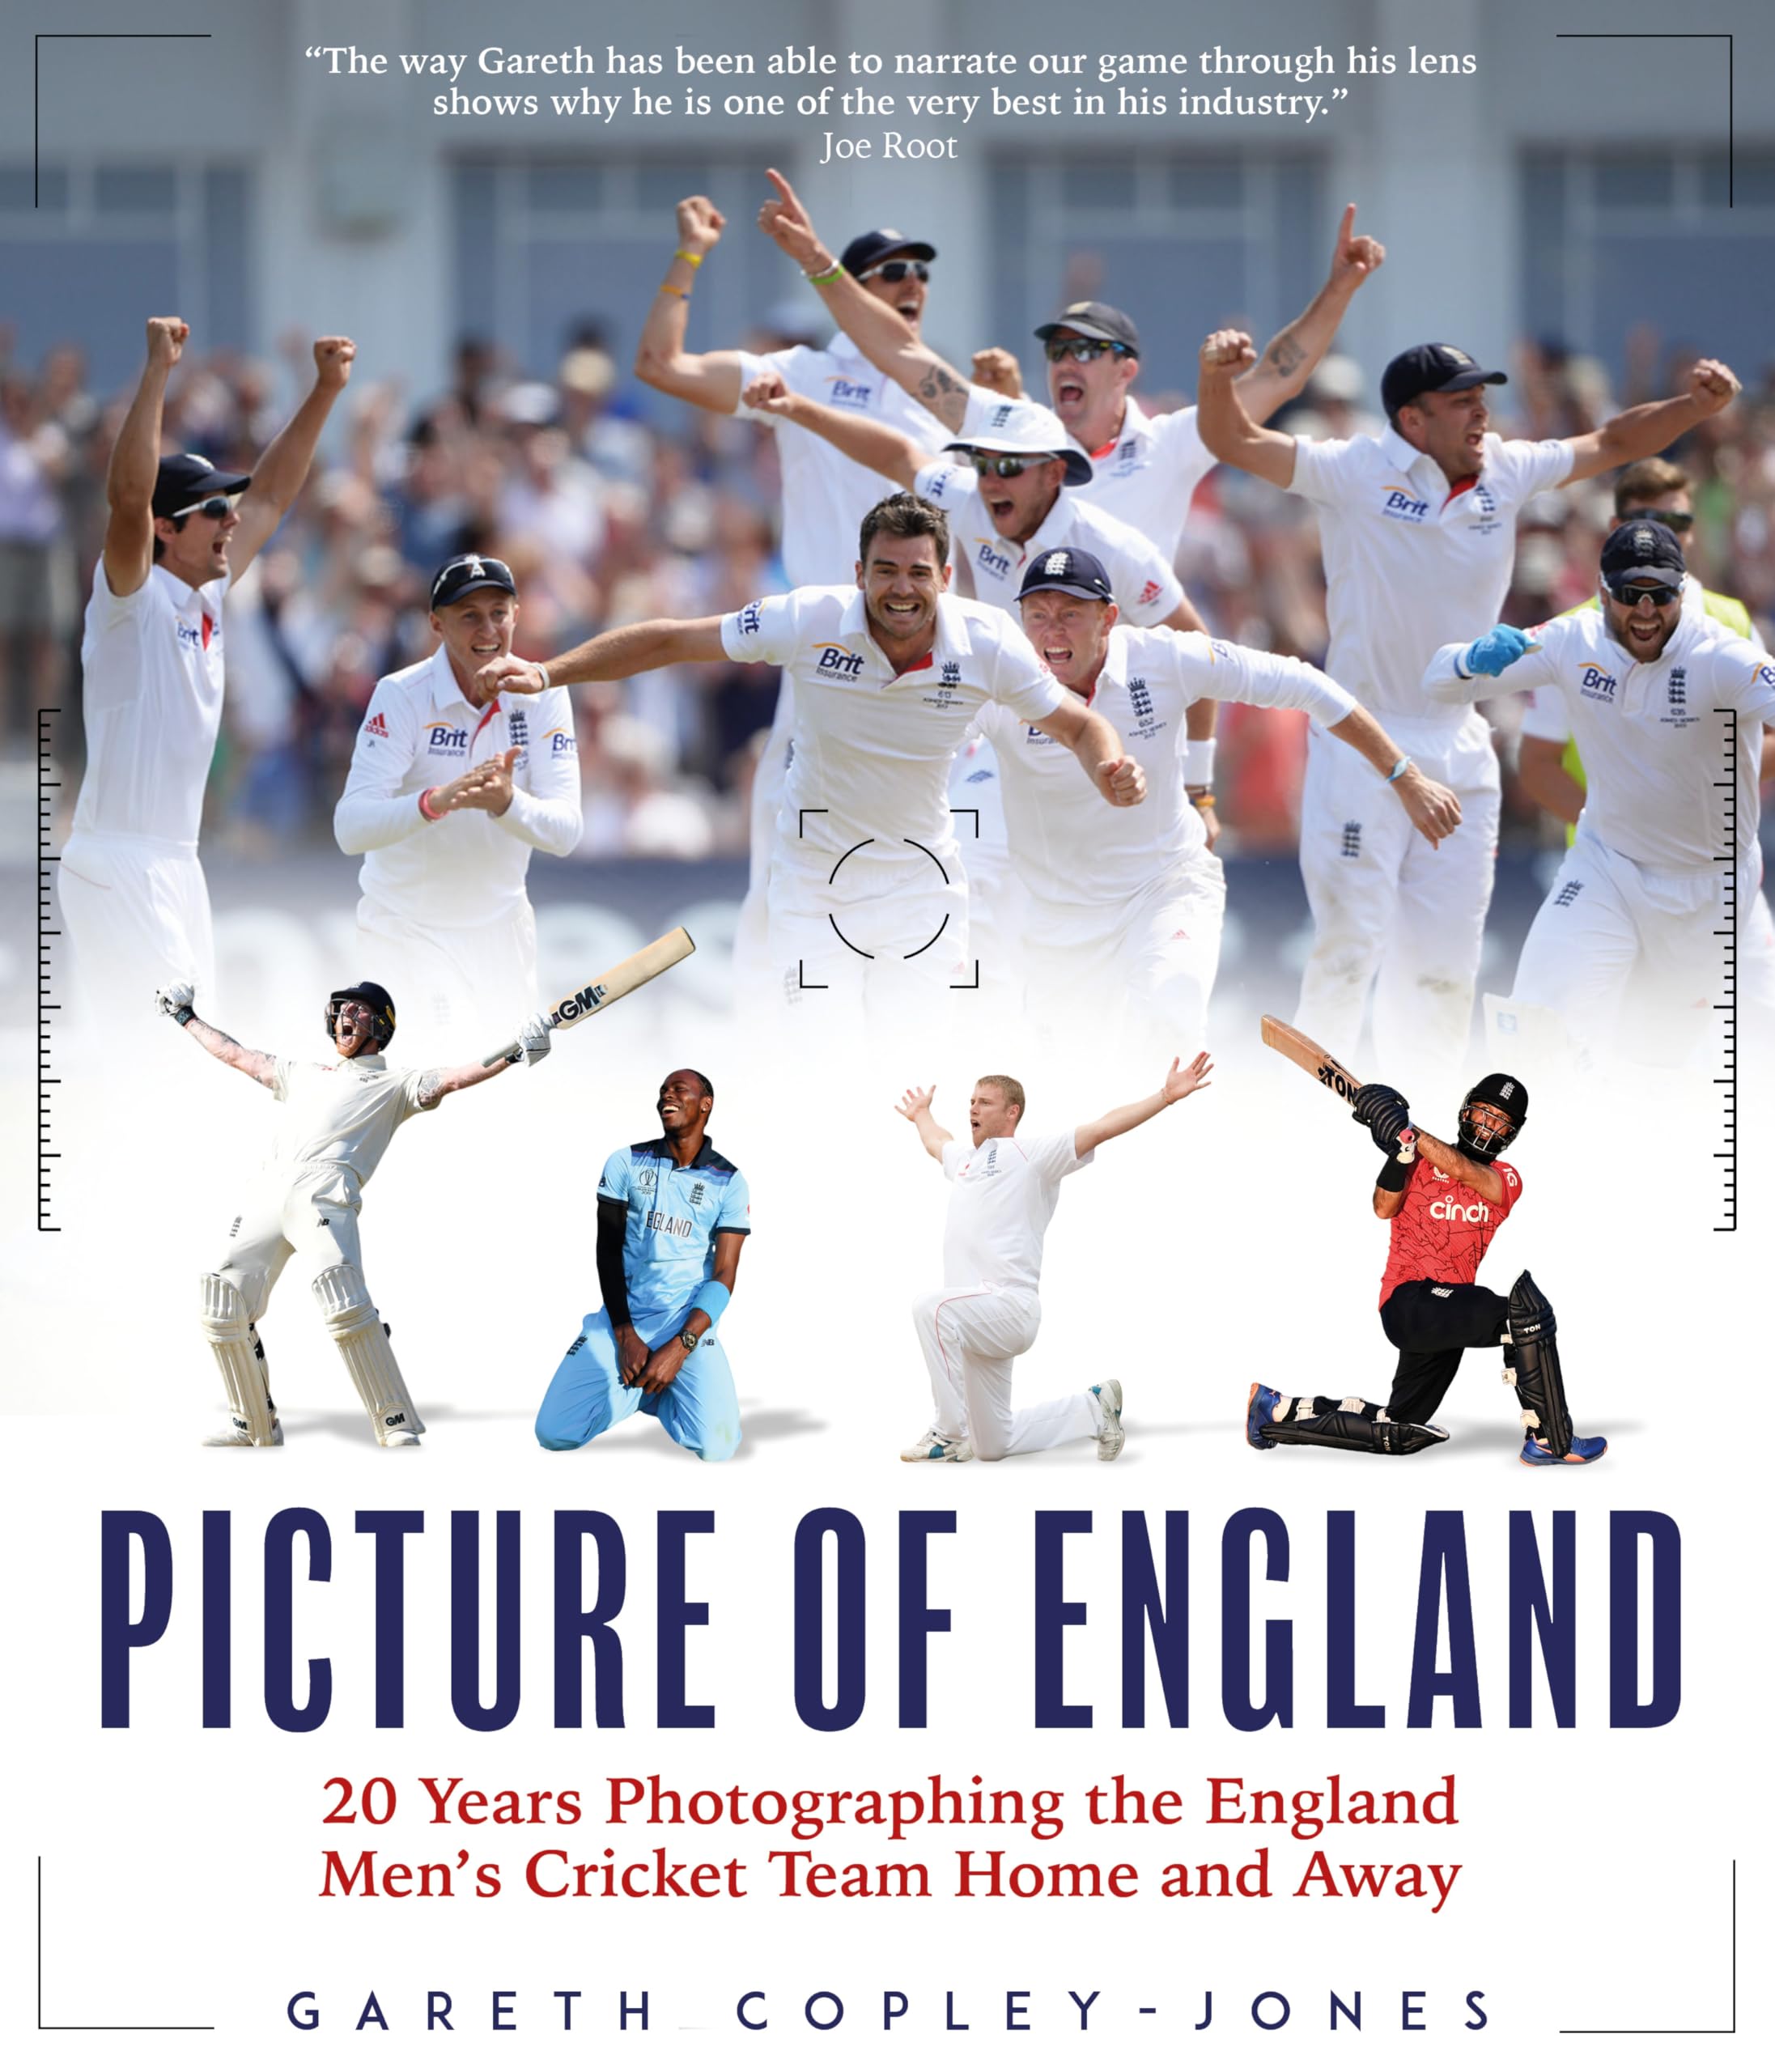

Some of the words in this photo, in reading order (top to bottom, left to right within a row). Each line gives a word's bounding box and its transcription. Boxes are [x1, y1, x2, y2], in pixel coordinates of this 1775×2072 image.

[1387, 491, 1429, 516] Brit
[979, 544, 1010, 575] Brit
[819, 648, 864, 675] Brit
[816, 667, 858, 683] Insurance
[1582, 668, 1617, 696] Brit
[430, 728, 469, 749] Brit
[427, 747, 466, 758] Insurance
[558, 986, 601, 1021] GM
[1502, 1167, 1518, 1187] IG
[1429, 1195, 1489, 1223] cinch
[316, 1217, 330, 1227] NB
[1523, 1323, 1541, 1334] TON
[701, 1339, 715, 1347] NB
[385, 1412, 406, 1426] GM
[1382, 1436, 1391, 1451] TON
